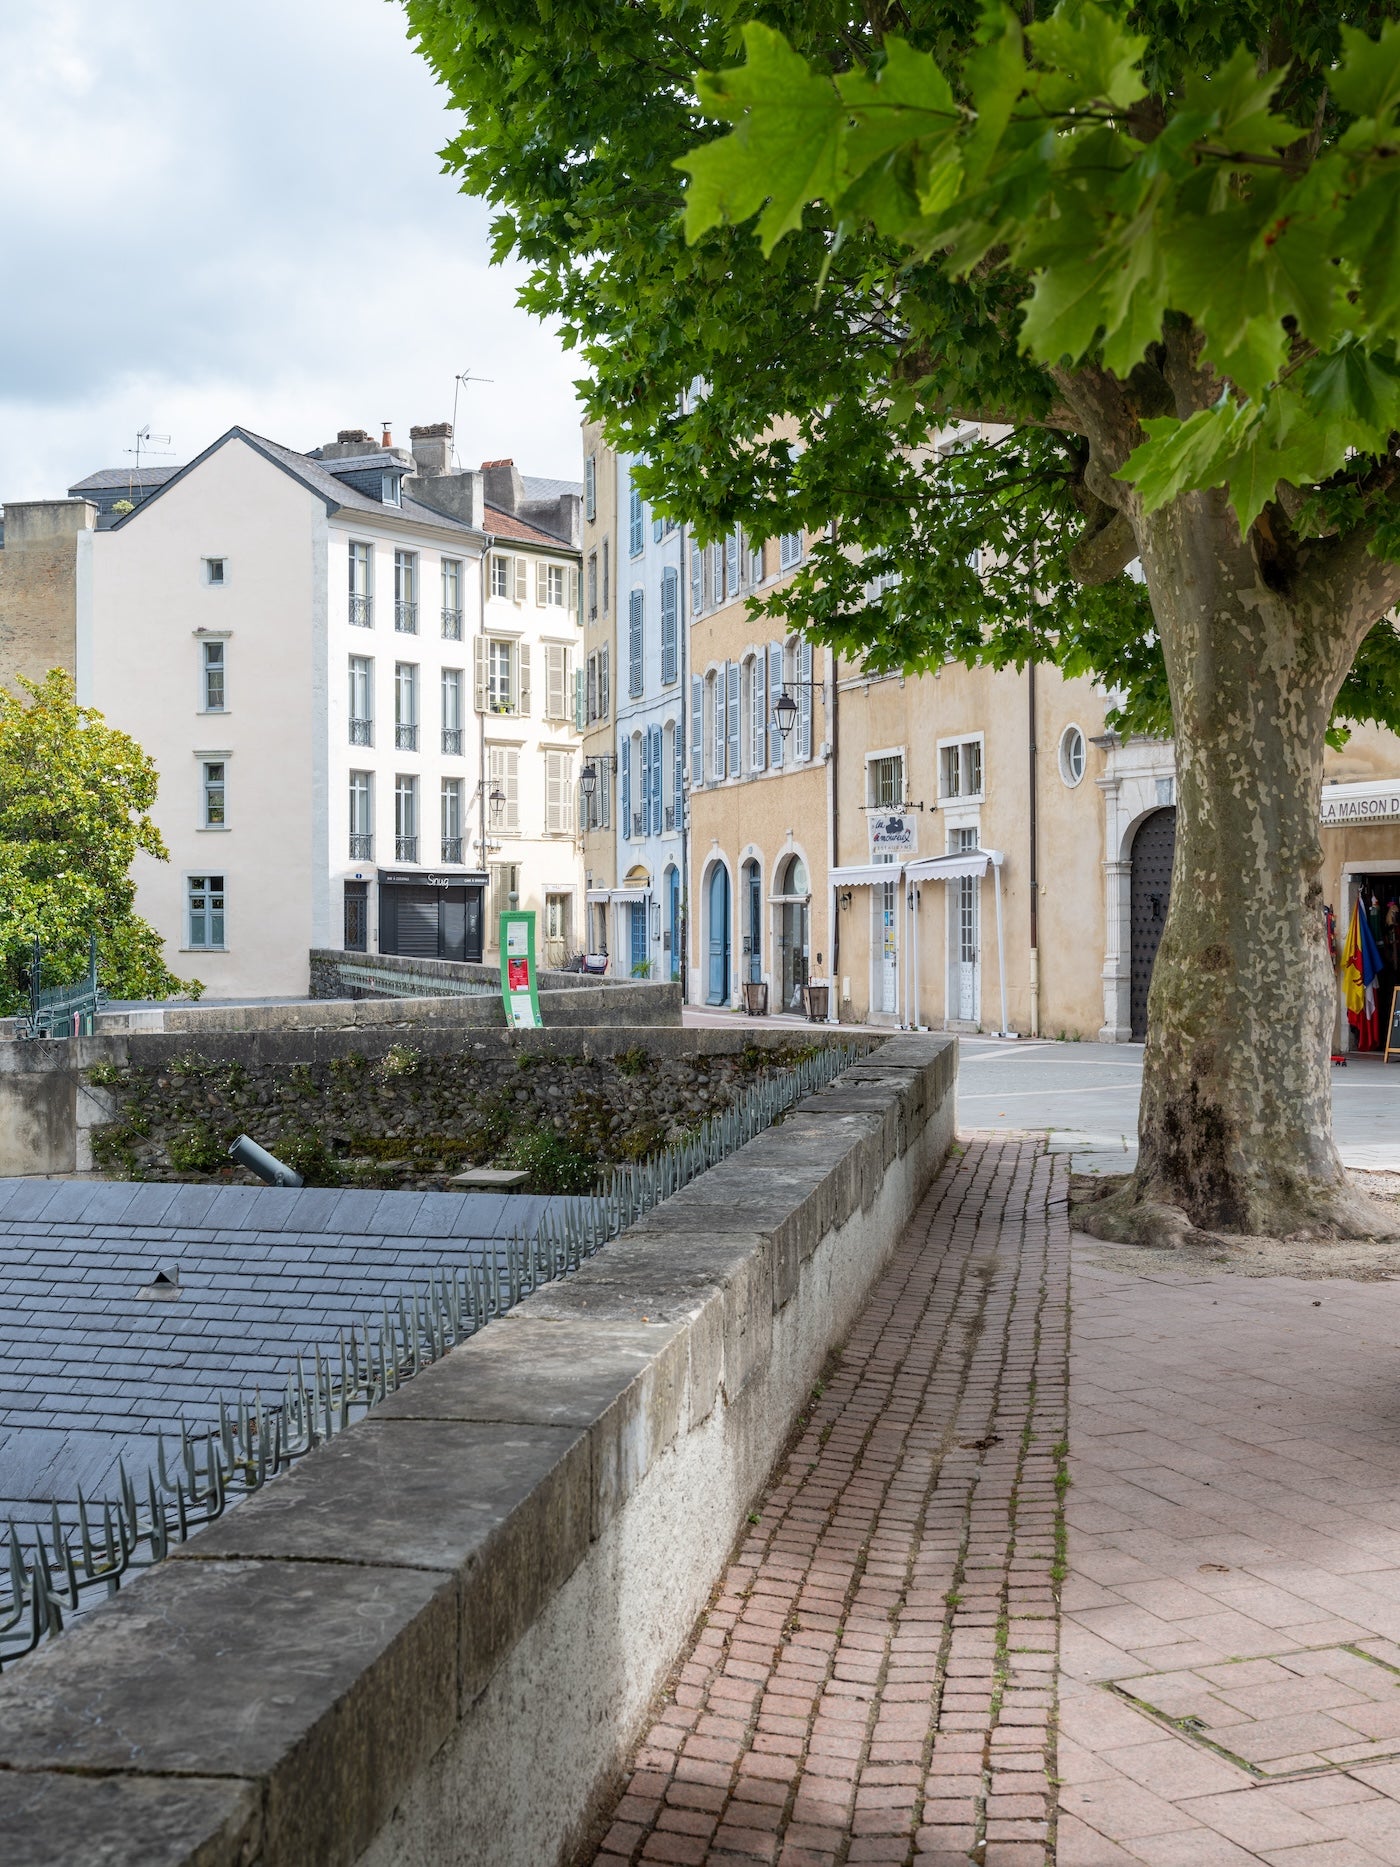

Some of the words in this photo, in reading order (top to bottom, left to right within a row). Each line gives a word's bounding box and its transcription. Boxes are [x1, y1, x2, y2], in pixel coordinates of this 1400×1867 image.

[1320, 804, 1336, 818] LA
[1339, 799, 1387, 817] MAISON
[427, 874, 449, 889] Snug
